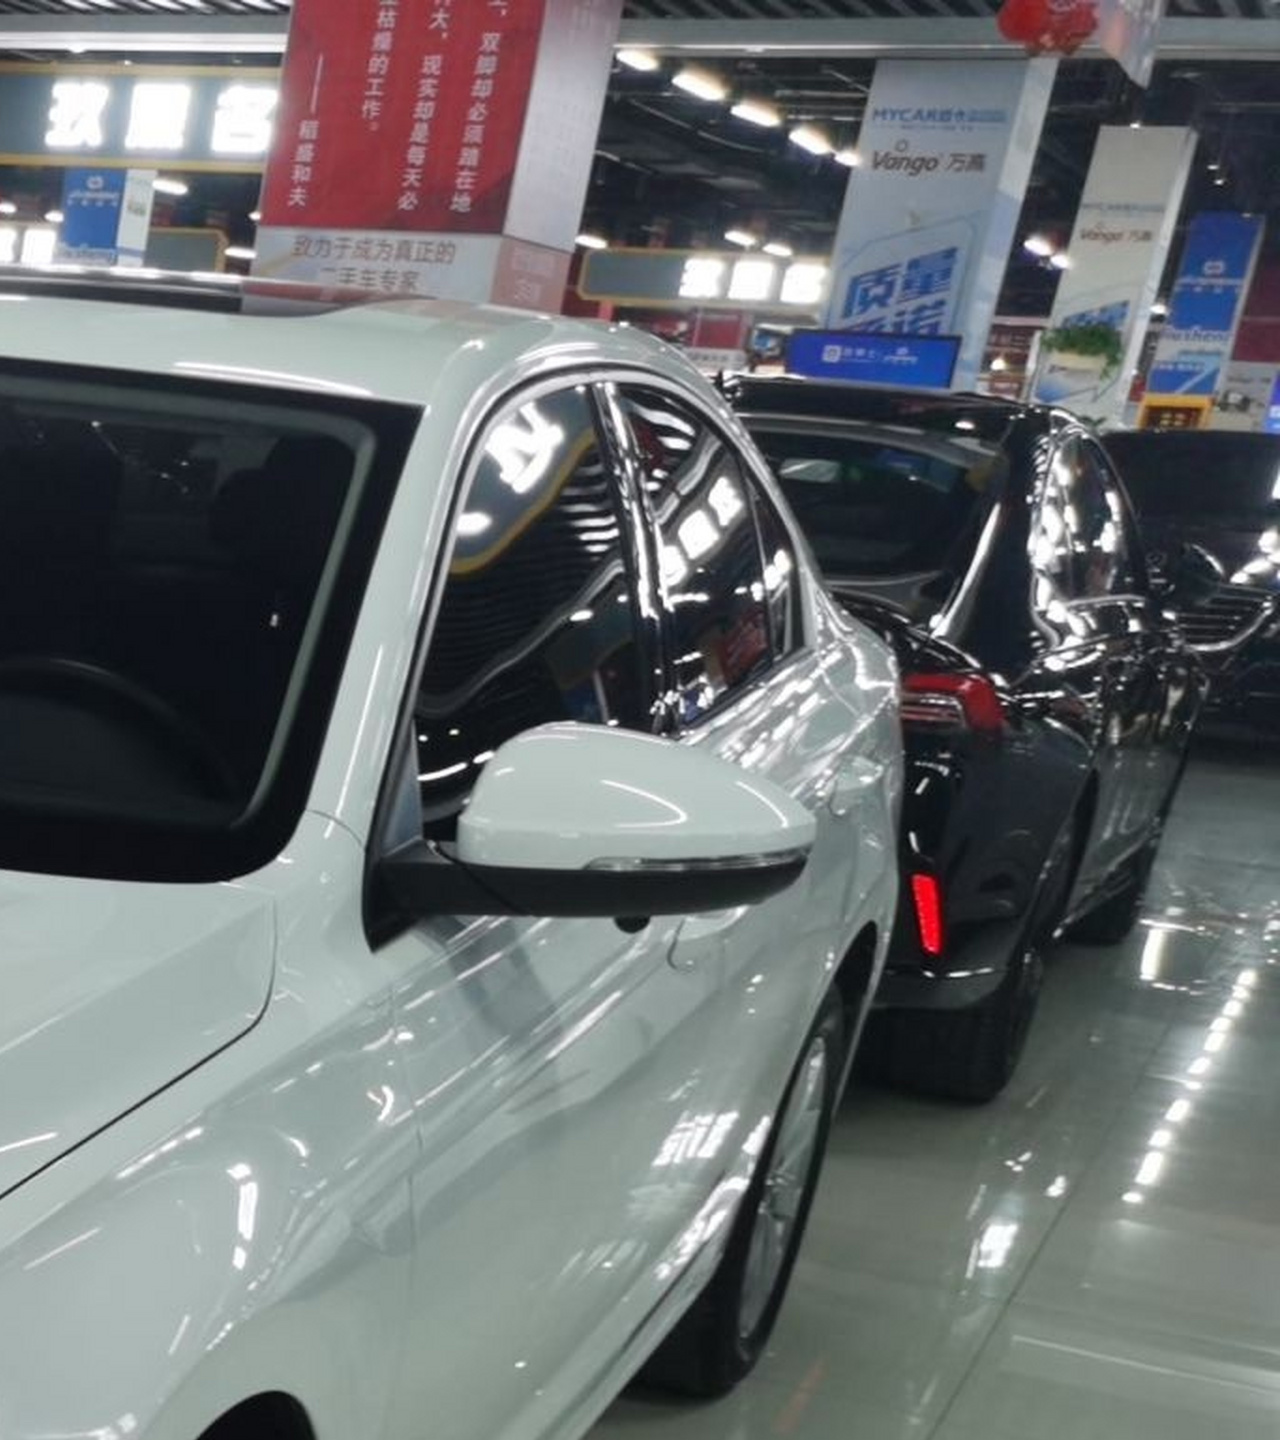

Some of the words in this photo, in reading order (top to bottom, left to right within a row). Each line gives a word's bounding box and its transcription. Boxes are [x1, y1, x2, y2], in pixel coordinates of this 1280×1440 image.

[872, 151, 939, 177] Vango
[291, 234, 457, 265] 致力于成为真正的
